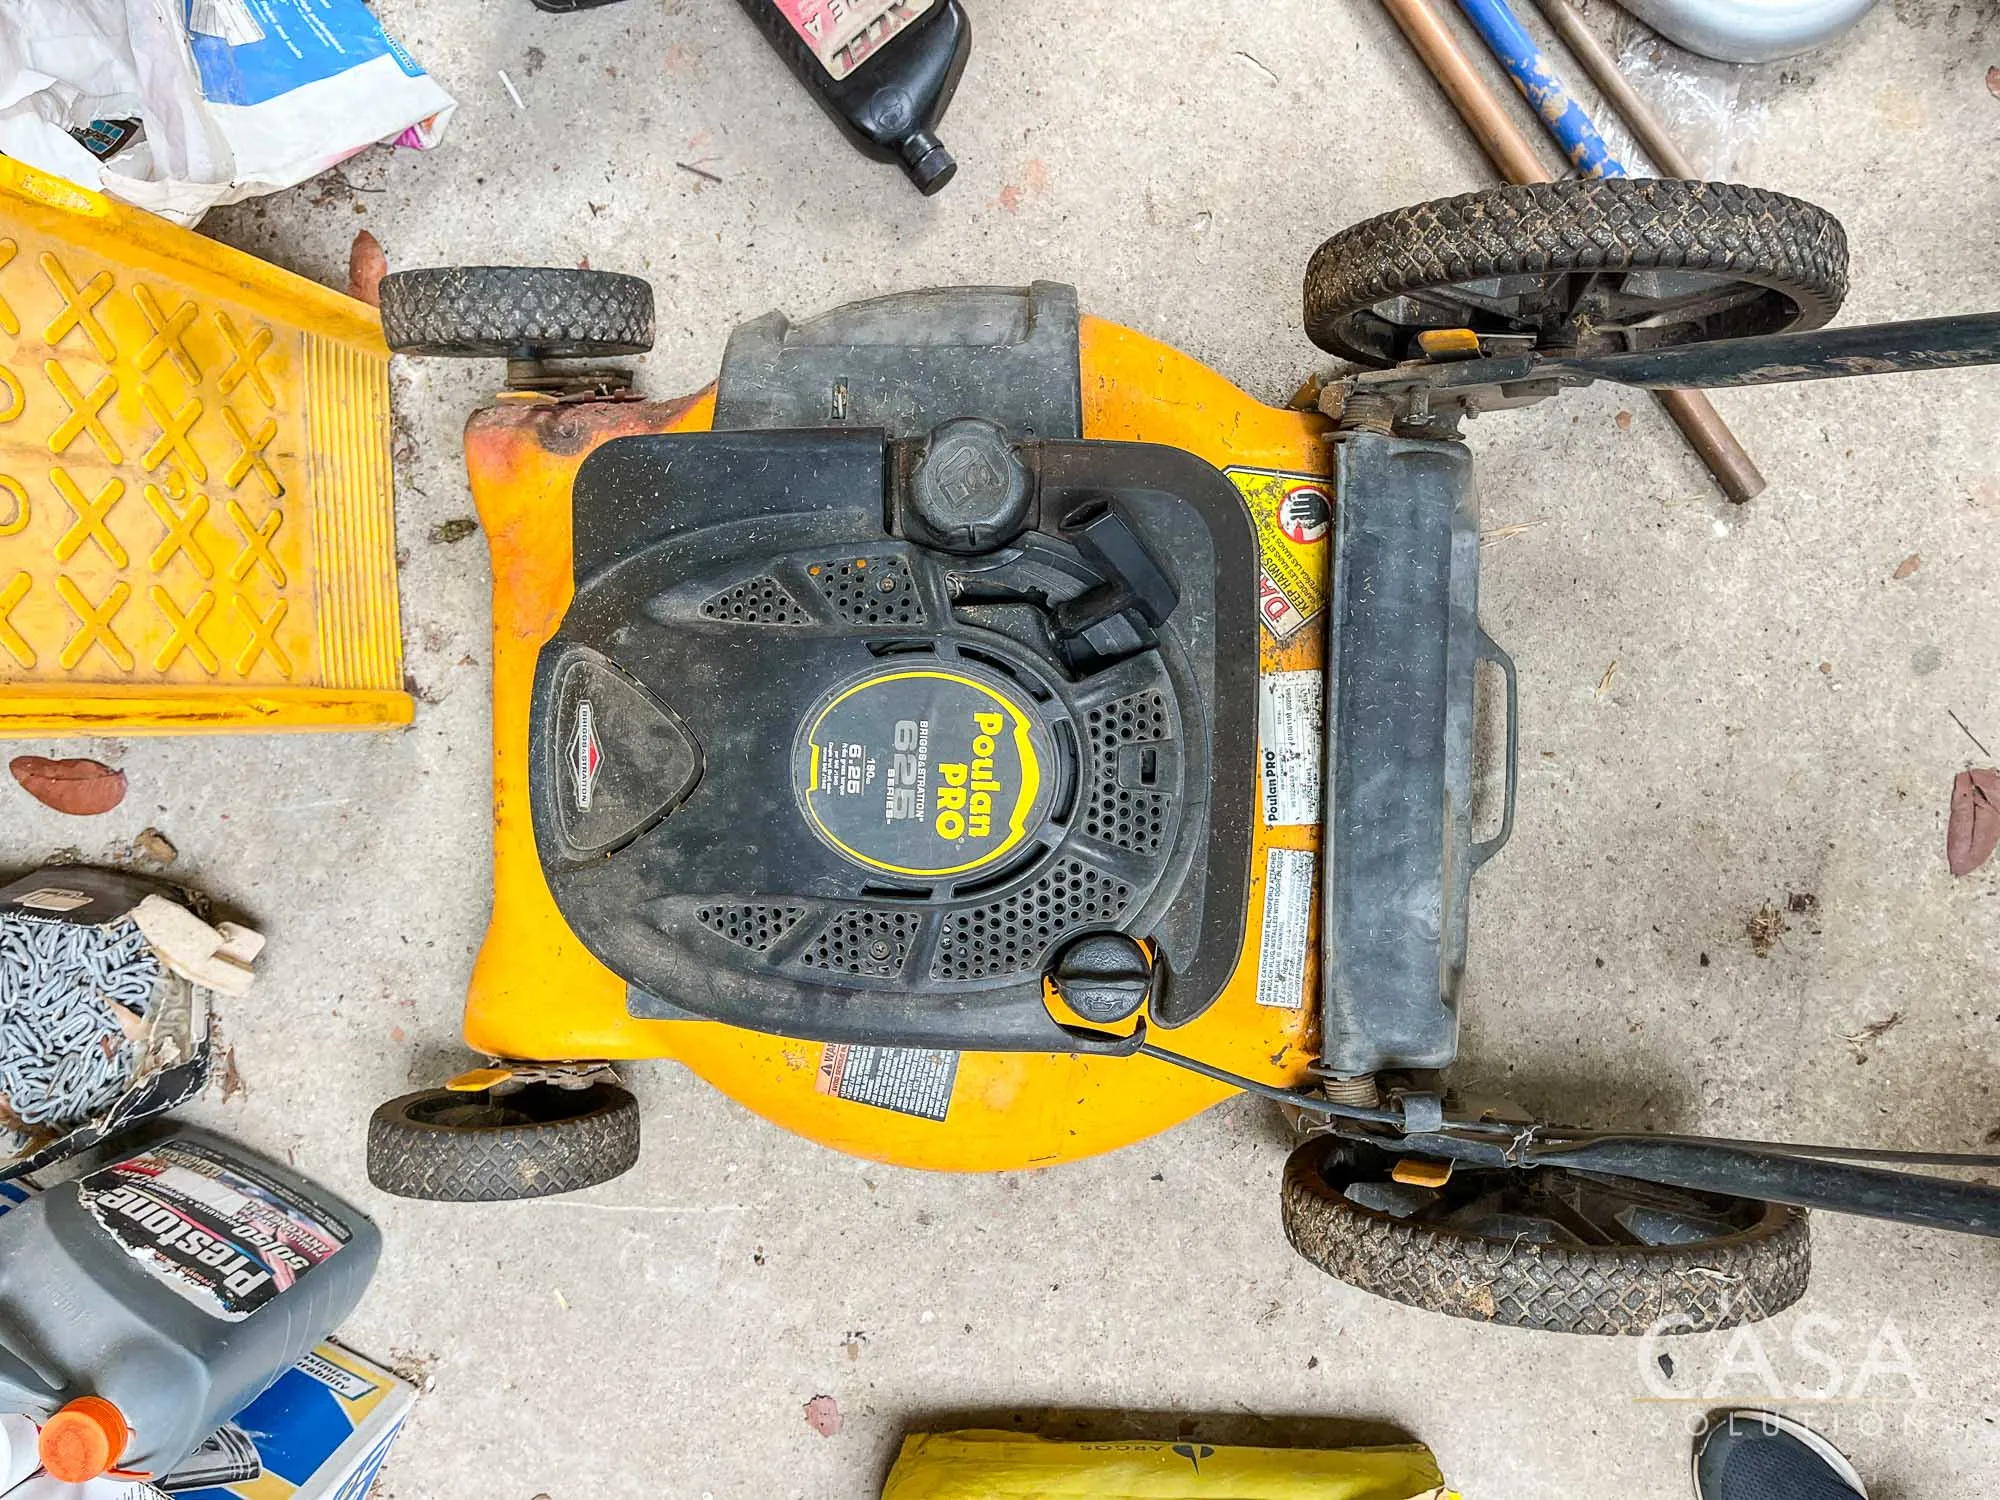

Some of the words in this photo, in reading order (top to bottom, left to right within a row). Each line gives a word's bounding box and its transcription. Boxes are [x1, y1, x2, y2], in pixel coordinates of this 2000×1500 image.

[1266, 543, 1276, 552] ET
[1272, 550, 1290, 570] MAINS
[1274, 537, 1293, 560] MANOS
[1290, 557, 1302, 571] LAS
[1262, 556, 1291, 589] HANDS
[1286, 568, 1298, 581] LES
[1285, 586, 1309, 612] KEEP
[1295, 578, 1316, 604] GARDEZ
[846, 743, 862, 794] 6.25
[893, 719, 917, 820] 625
[967, 711, 1003, 837] Poulan
[1264, 750, 1276, 777] PRO
[884, 767, 895, 819] SERIES
[935, 762, 968, 840] PRO
[1266, 778, 1278, 821] Poulan
[1268, 850, 1277, 884] ATTACHED
[1266, 885, 1274, 918] PROPERLY
[1265, 919, 1271, 928] BE
[1261, 948, 1269, 978] CATCHER
[1266, 991, 1272, 1002] OR
[1272, 897, 1280, 914] WITH
[94, 1186, 272, 1297] Prestone
[230, 1221, 310, 1272] 50/50
